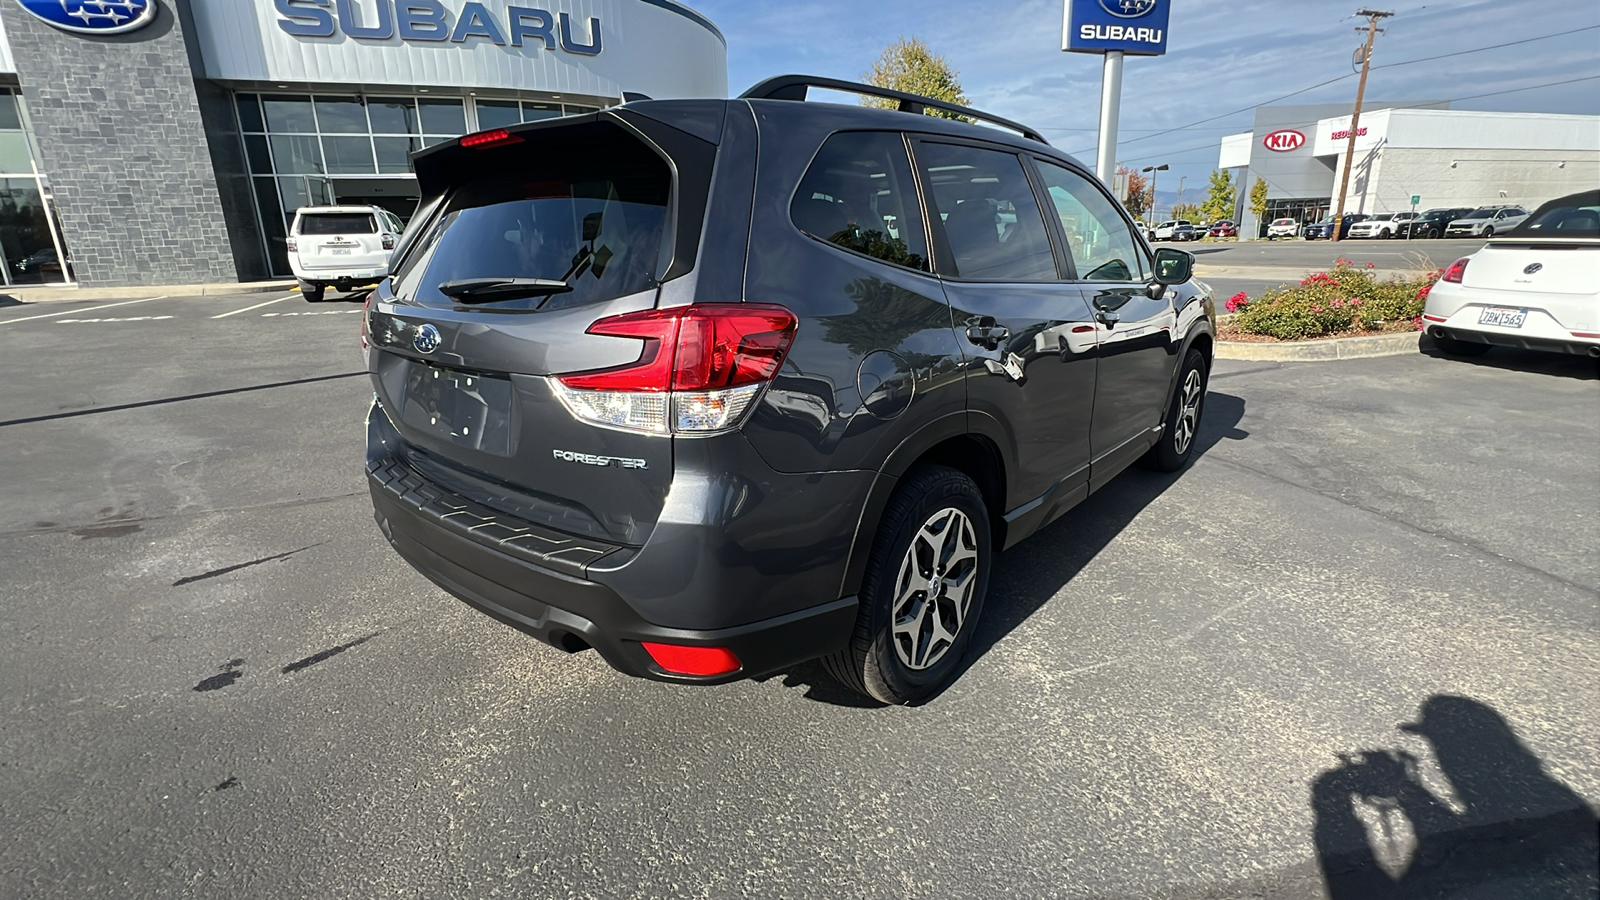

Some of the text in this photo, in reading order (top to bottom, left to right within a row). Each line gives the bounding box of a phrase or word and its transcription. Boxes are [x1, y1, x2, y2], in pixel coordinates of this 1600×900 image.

[277, 0, 603, 56] SUBARU
[1080, 24, 1162, 44] SUBARU
[1271, 135, 1298, 148] KIA
[552, 449, 649, 470] FORESTER
